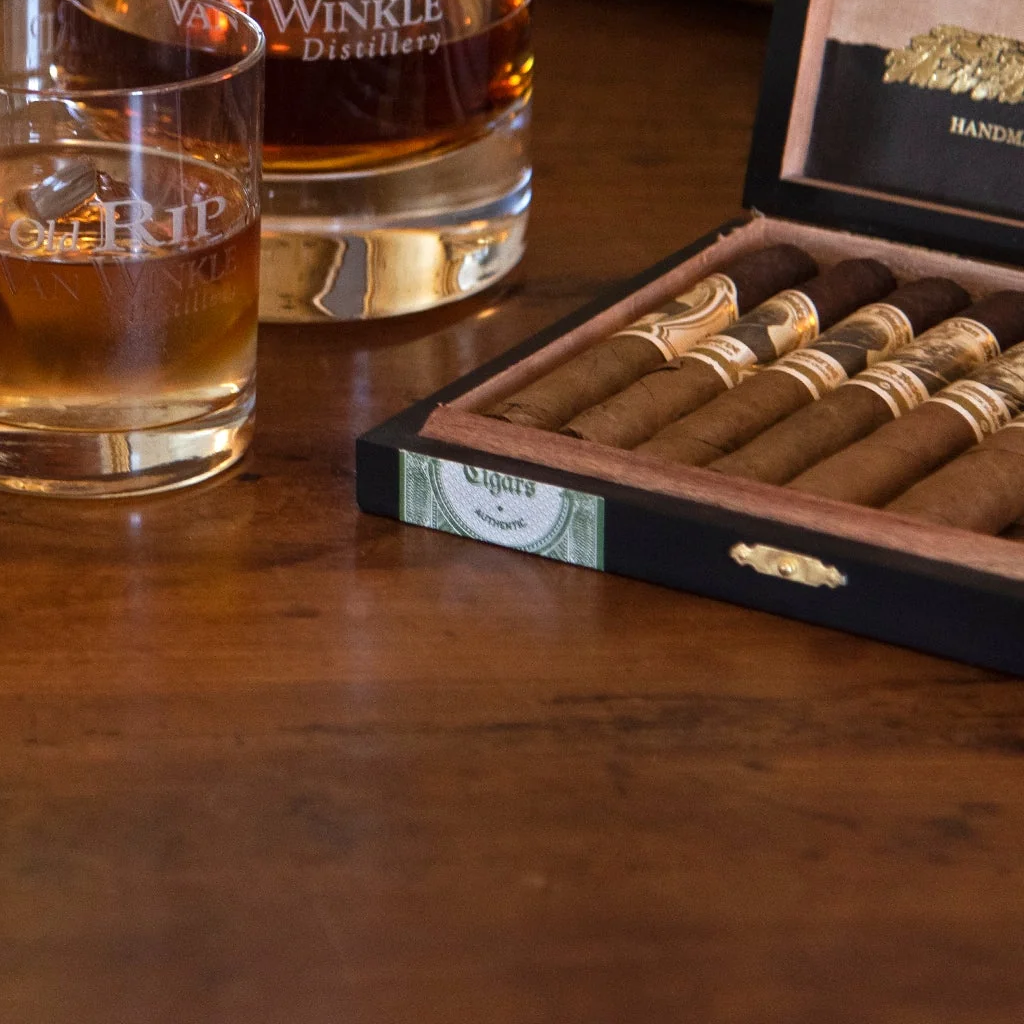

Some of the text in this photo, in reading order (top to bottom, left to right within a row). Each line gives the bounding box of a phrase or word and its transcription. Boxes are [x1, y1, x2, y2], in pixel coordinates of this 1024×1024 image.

[302, 31, 442, 63] Distillery
[950, 115, 1024, 147] HANDM
[9, 196, 227, 253] Old RIP
[475, 508, 528, 531] AUTHENTIC
